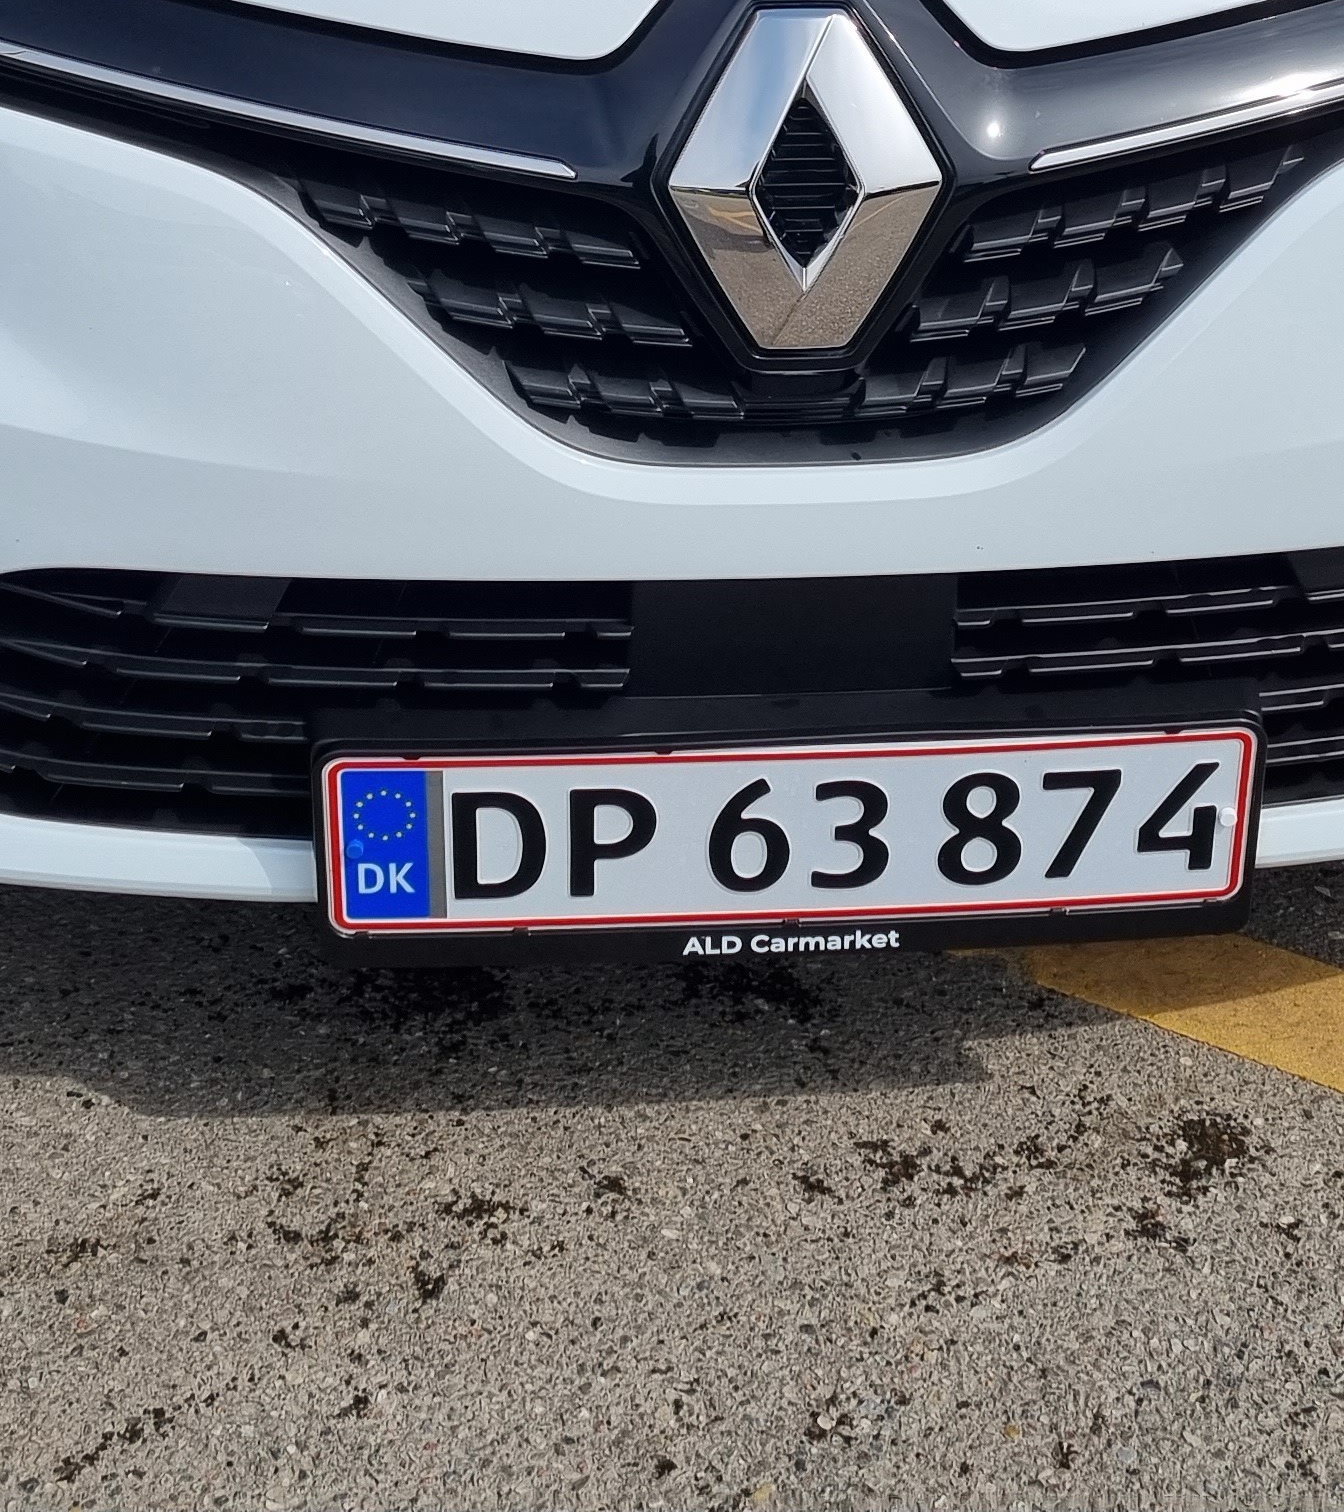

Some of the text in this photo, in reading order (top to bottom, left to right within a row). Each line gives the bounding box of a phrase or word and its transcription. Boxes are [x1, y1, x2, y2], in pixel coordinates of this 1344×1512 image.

[451, 761, 1220, 899] DP 63 874
[357, 862, 416, 894] DK
[682, 929, 901, 956] ALD Carmarket
